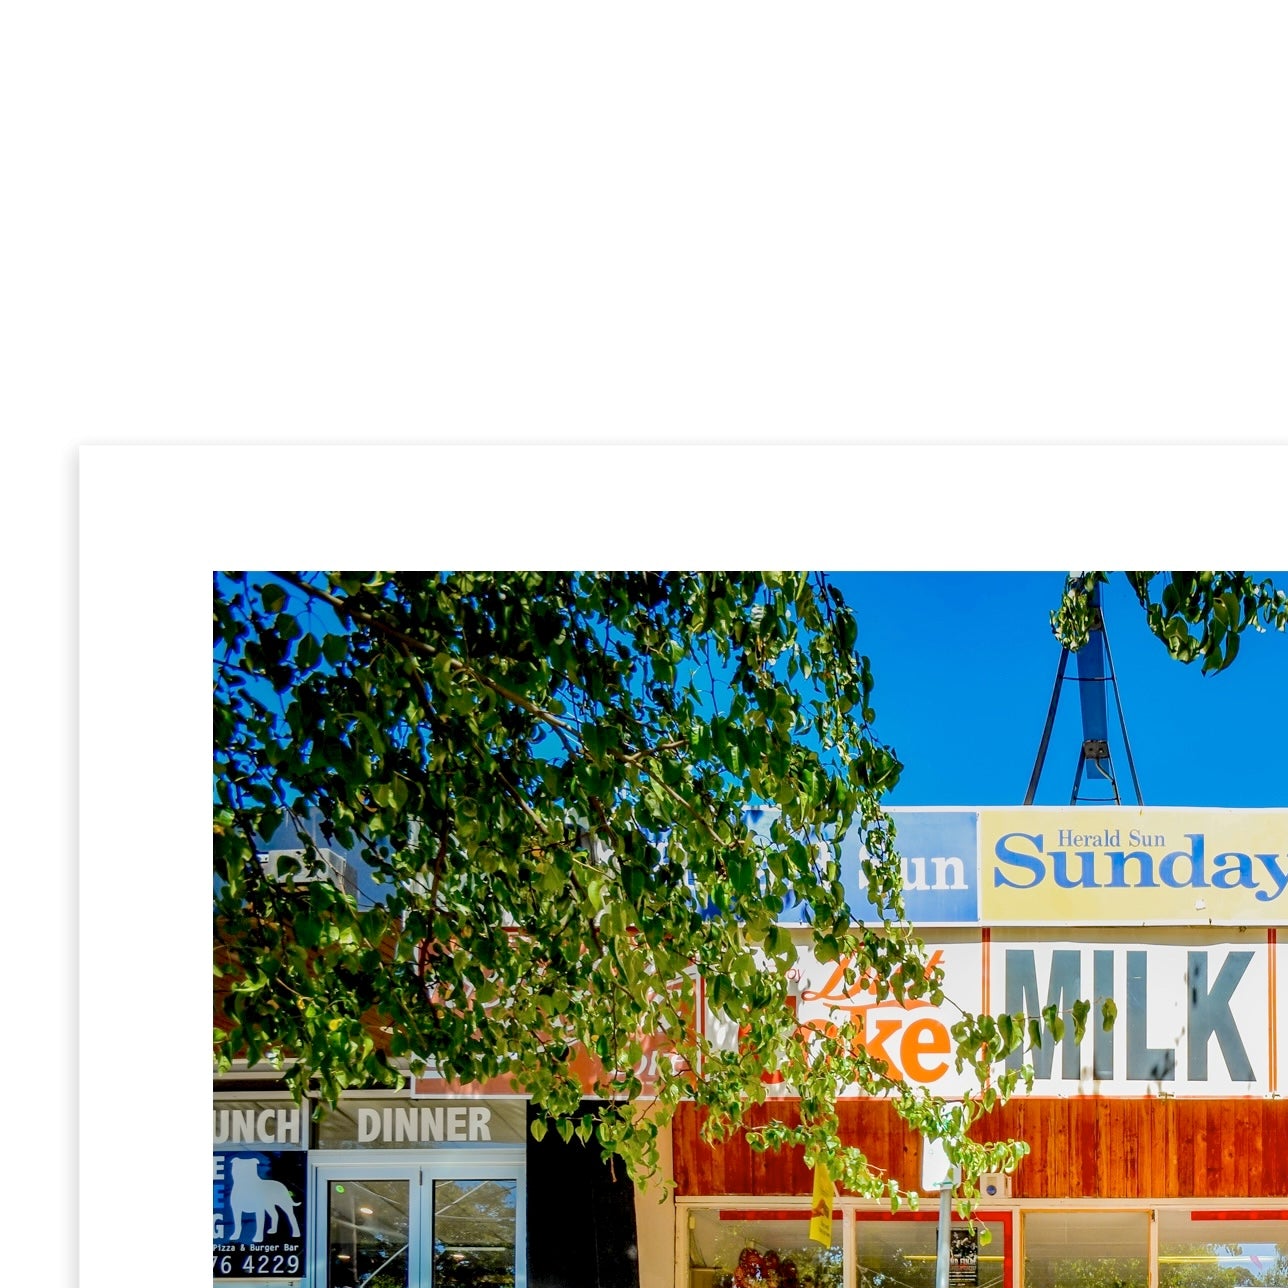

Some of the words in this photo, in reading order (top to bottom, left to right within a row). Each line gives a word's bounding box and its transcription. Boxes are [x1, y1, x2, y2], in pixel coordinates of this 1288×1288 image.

[1058, 829, 1121, 848] Herald
[1128, 829, 1166, 848] Sun
[1005, 948, 1257, 1082] MILK
[357, 1106, 492, 1142] DINNER
[213, 1244, 236, 1252] Pizza
[240, 1244, 246, 1252] &
[250, 1244, 280, 1254] Burger
[284, 1244, 300, 1252] Bar
[242, 1255, 300, 1274] 4229
